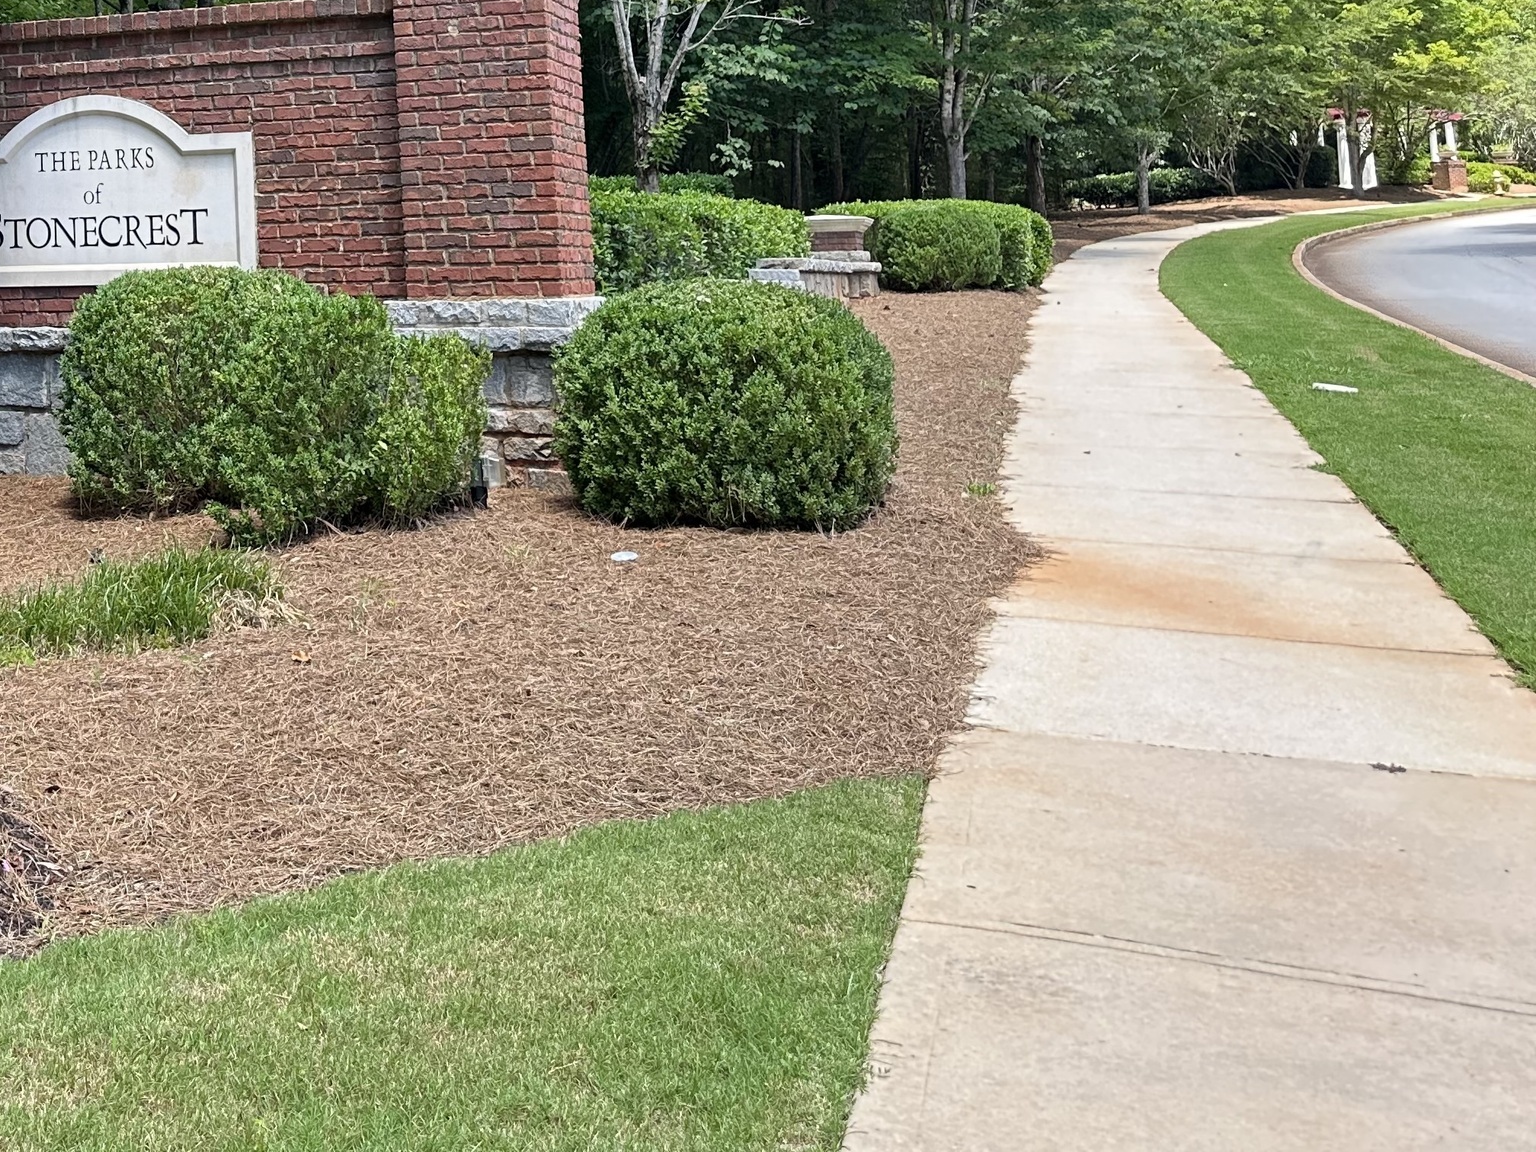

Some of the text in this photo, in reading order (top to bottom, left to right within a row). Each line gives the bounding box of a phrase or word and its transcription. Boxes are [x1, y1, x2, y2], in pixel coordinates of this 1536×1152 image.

[35, 146, 156, 173] THE PARKS
[83, 182, 105, 205] of
